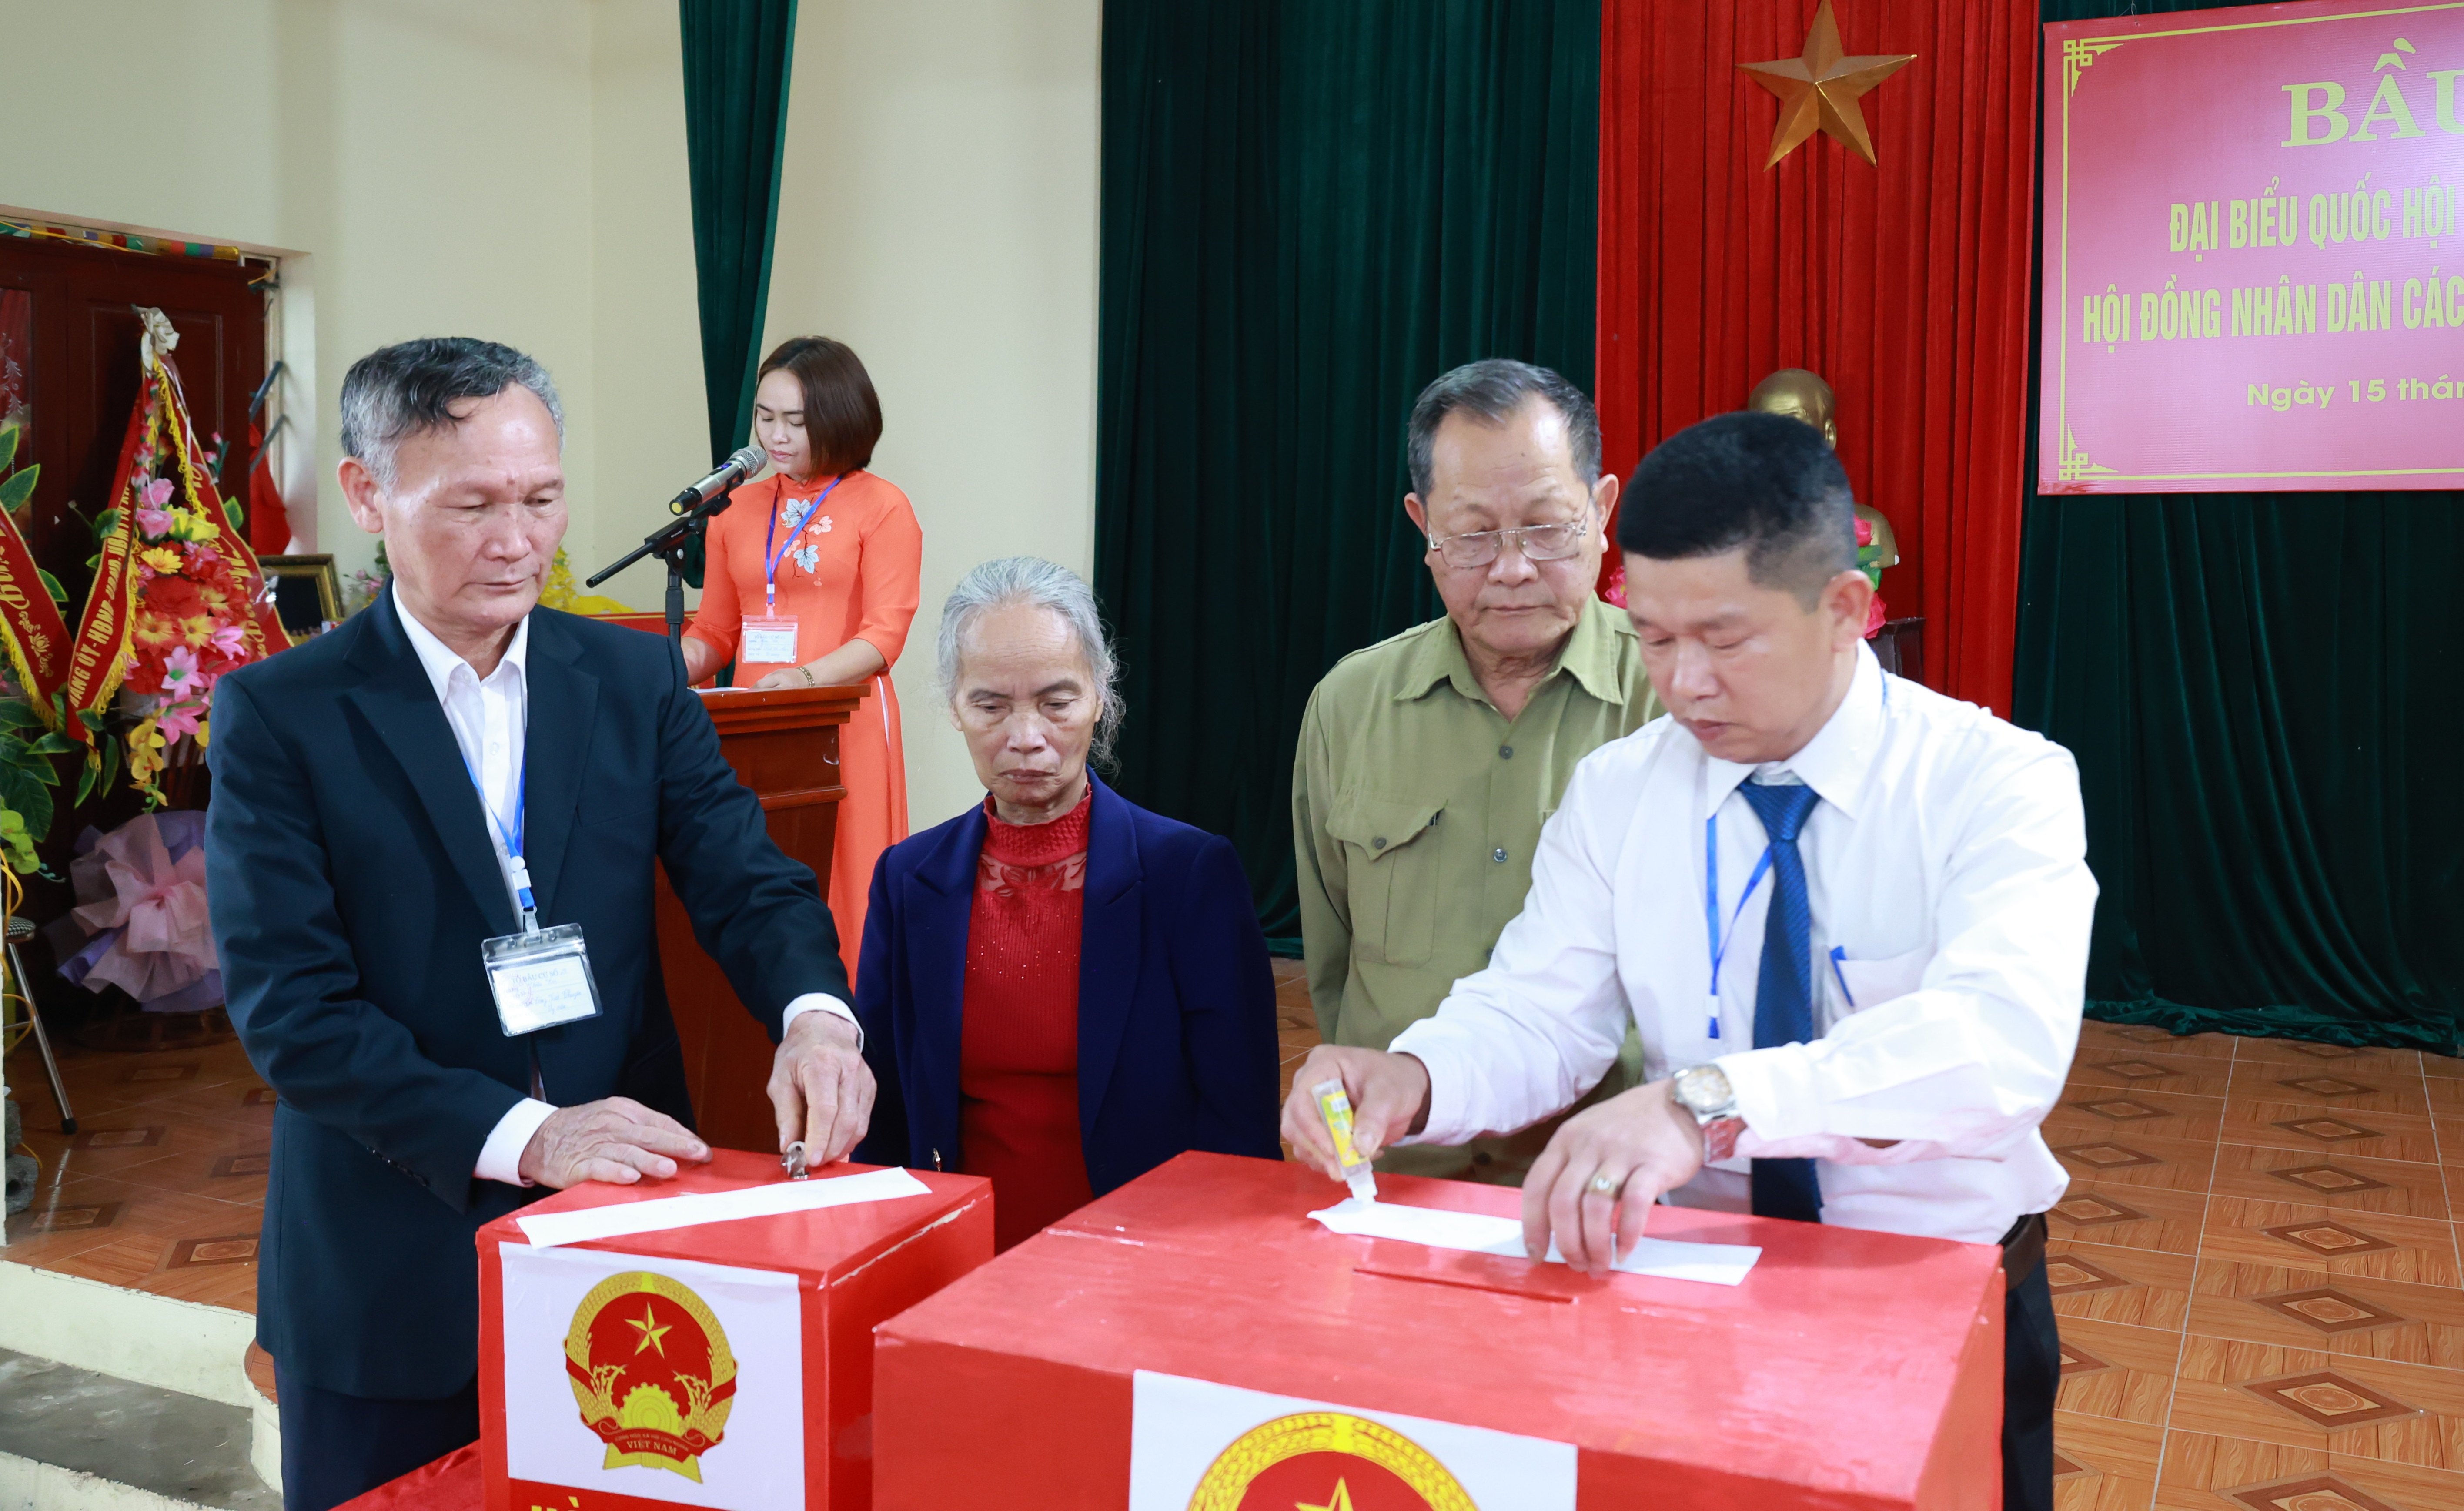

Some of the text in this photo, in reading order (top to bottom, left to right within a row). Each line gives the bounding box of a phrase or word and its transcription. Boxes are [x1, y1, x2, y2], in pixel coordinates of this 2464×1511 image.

[2170, 172, 2454, 262] ĐẠI BIỂU QUỐC HỘI
[2083, 265, 2464, 353] HỘI ĐỒNG NHÂN DÂN CÁC
[2247, 380, 2335, 411] Ngày
[2349, 379, 2386, 402] 15
